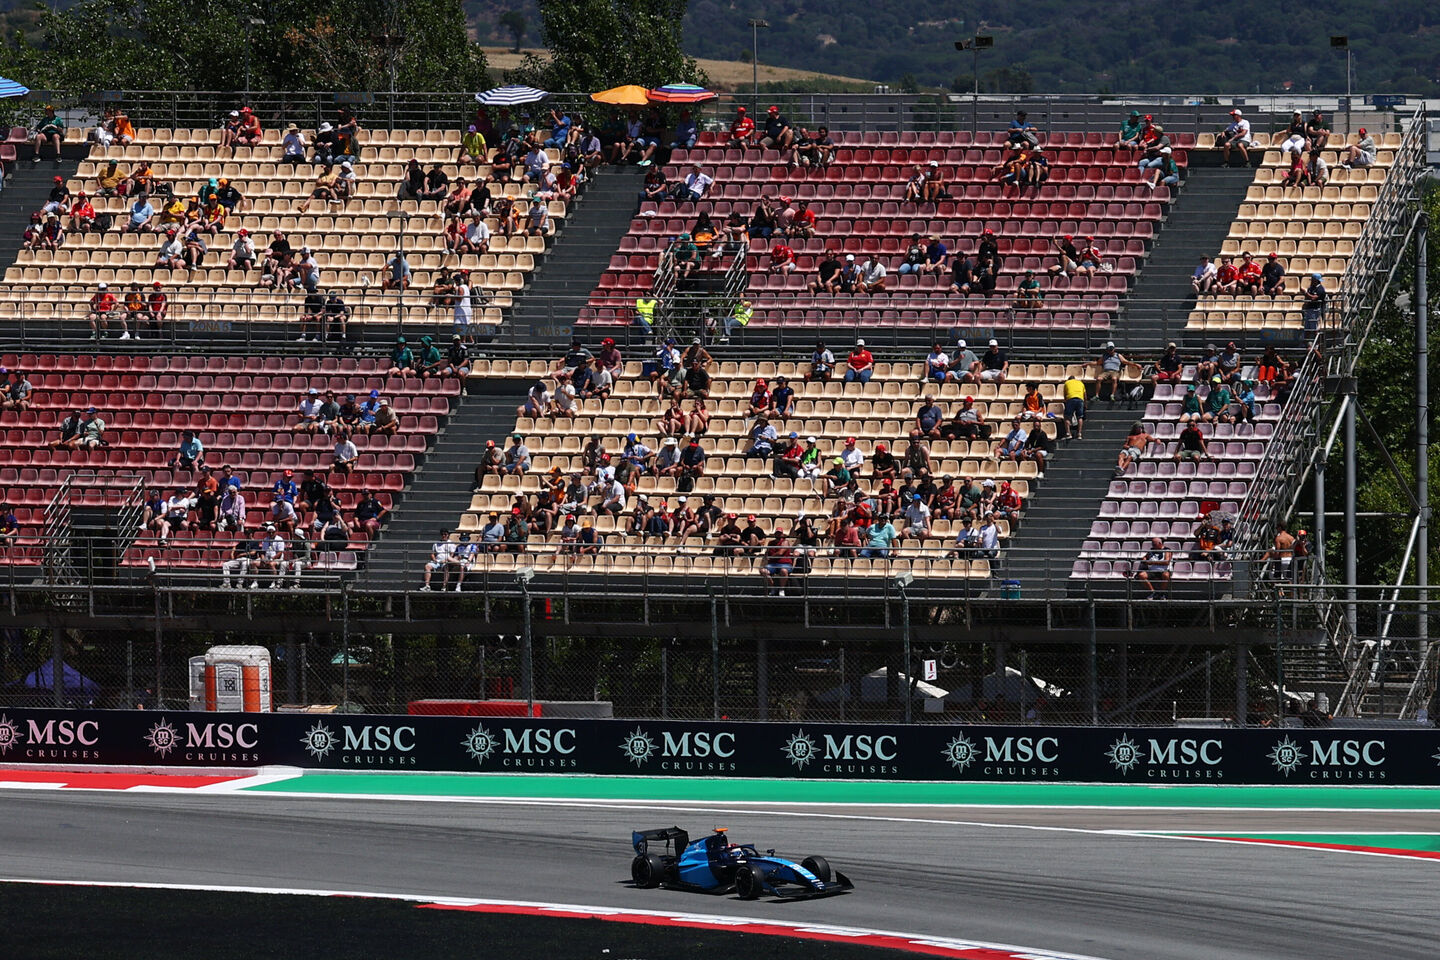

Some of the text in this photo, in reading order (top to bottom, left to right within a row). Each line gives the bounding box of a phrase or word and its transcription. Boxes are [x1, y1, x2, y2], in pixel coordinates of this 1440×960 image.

[26, 720, 98, 745] MSC
[186, 723, 257, 748] MSC
[342, 726, 415, 751] MSC
[502, 729, 575, 753] MSC
[662, 732, 735, 757] MSC
[27, 750, 98, 758] CRUISES
[186, 753, 258, 761] CRUISES
[824, 735, 896, 760] MSC
[984, 737, 1058, 762] MSC
[1148, 739, 1222, 764] MSC
[1310, 740, 1385, 765] MSC
[662, 762, 735, 770] CRUISES
[824, 765, 897, 773] CRUISES
